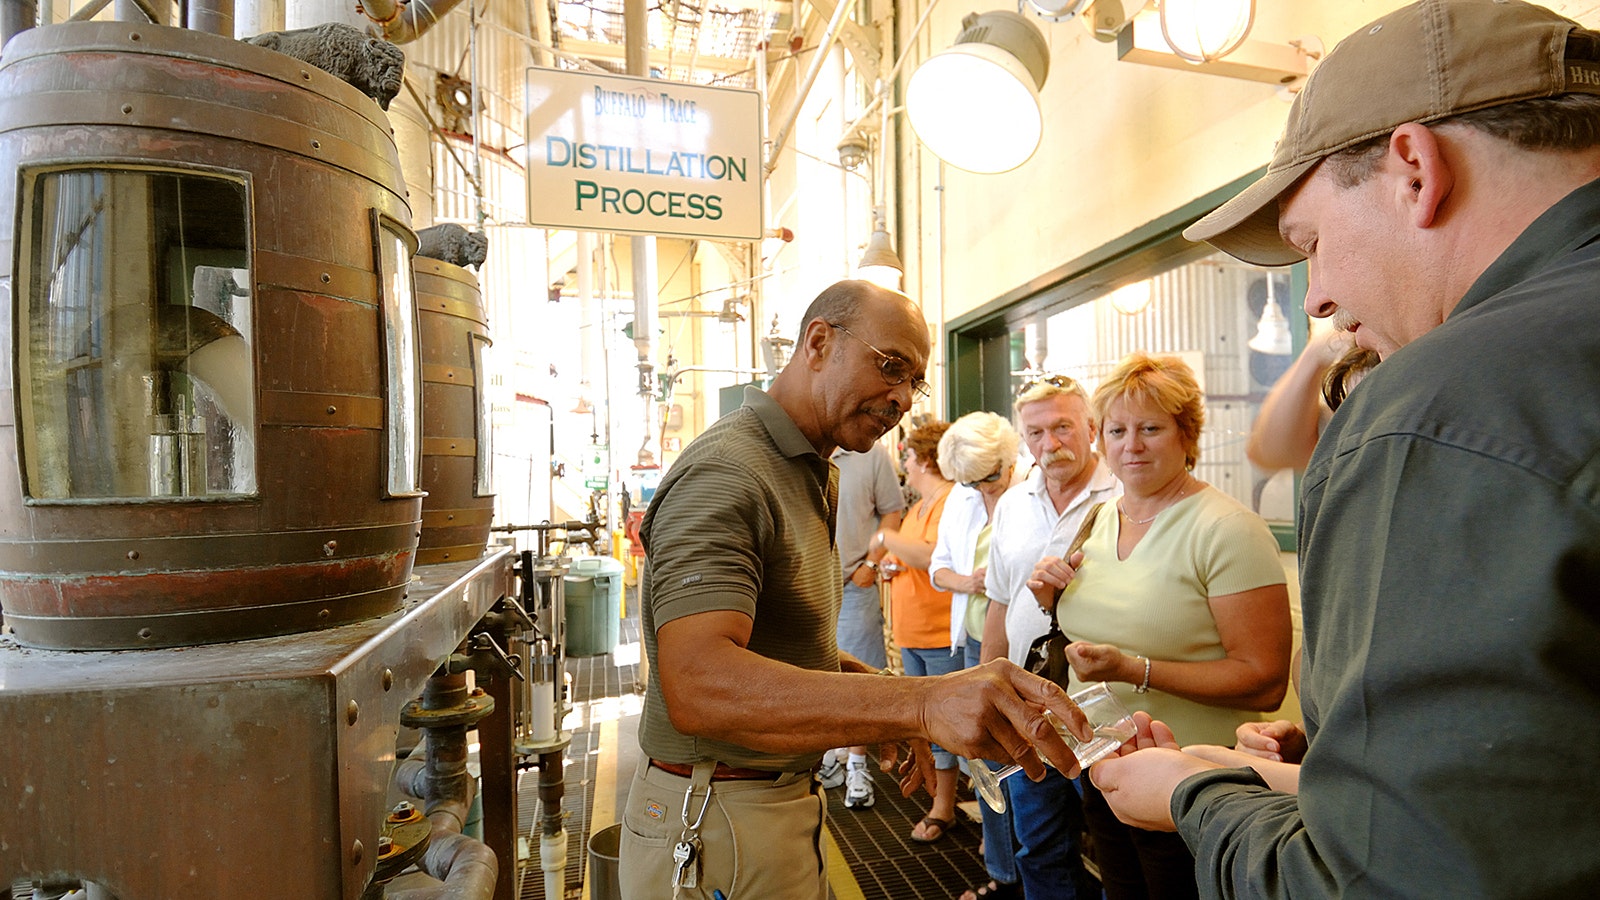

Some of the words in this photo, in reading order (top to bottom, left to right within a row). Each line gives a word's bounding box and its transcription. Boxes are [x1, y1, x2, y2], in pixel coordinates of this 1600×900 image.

[594, 85, 646, 119] BUFFALO
[660, 93, 697, 123] TRACE
[546, 135, 747, 182] DISTILLATION
[575, 180, 723, 221] PROCESS
